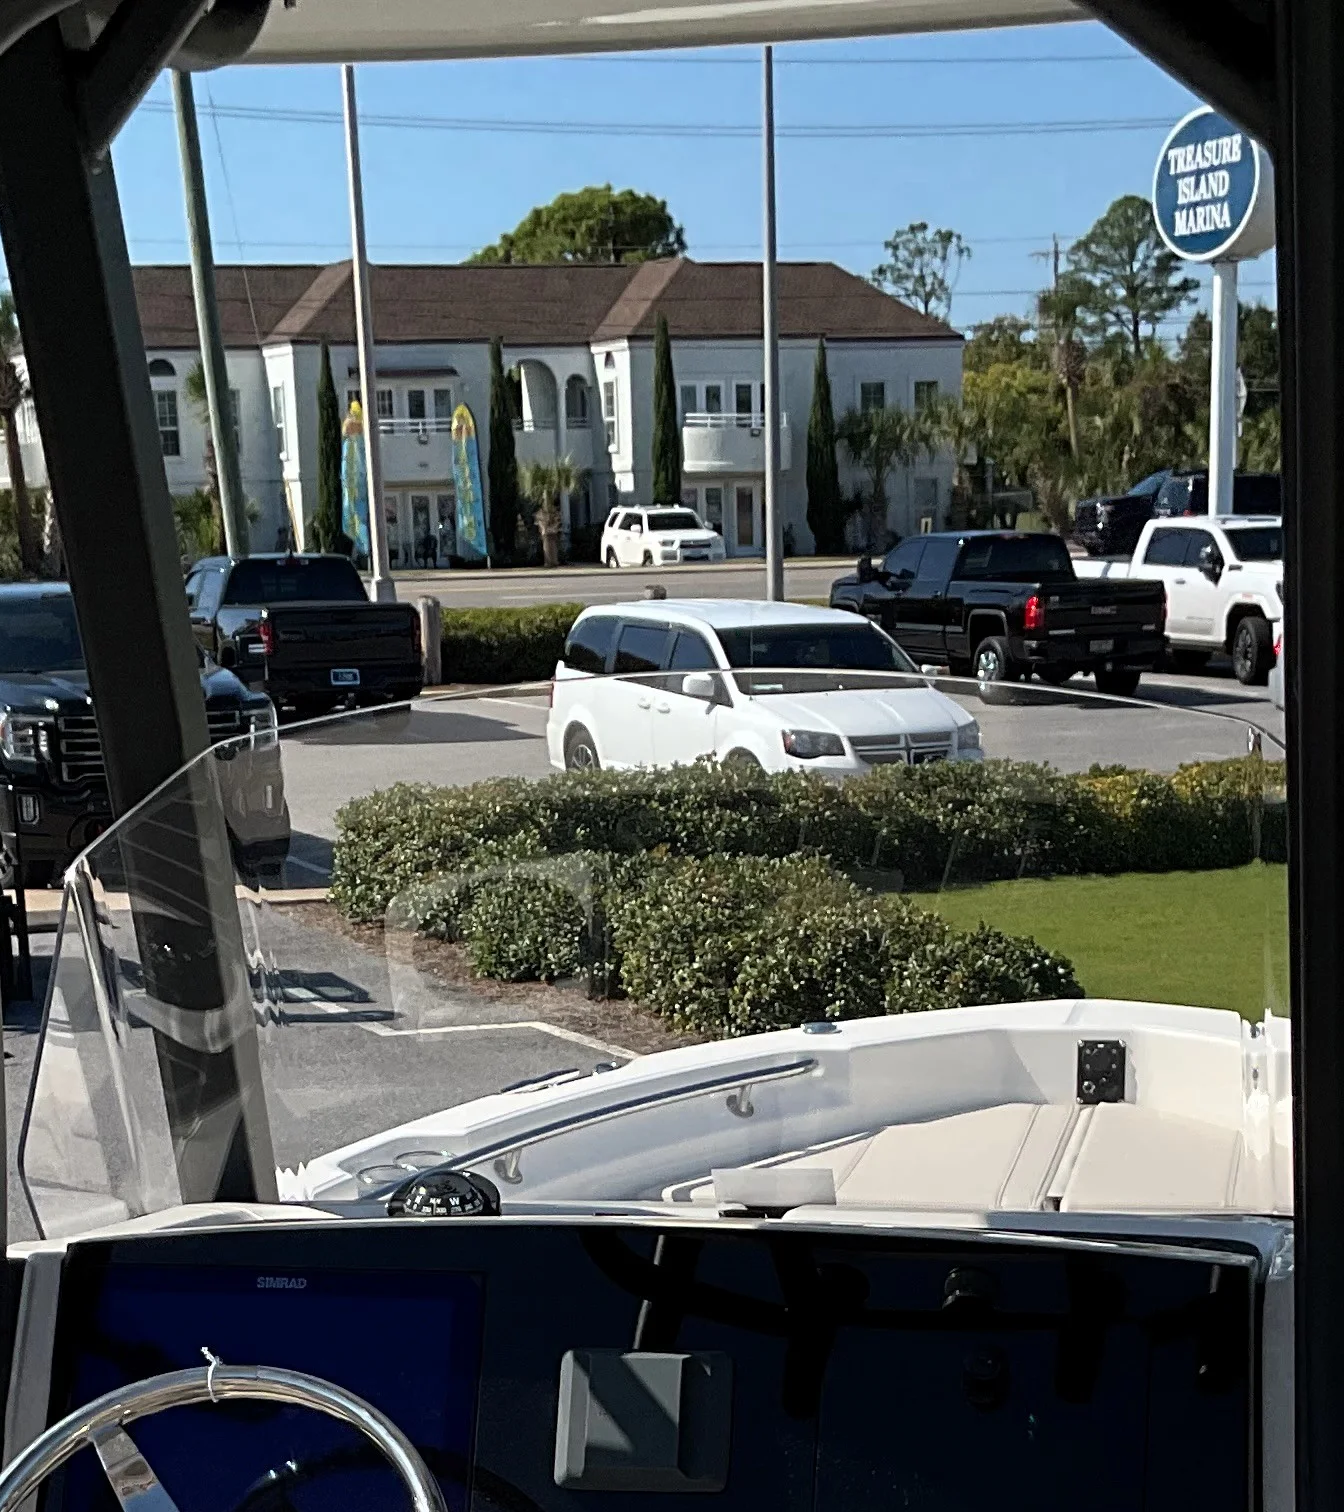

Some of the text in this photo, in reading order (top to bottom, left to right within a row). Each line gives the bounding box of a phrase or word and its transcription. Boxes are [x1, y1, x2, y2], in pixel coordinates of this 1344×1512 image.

[1167, 133, 1242, 175] TREASURE
[1177, 169, 1230, 204] ISLAND
[1174, 201, 1231, 236] MARINA
[449, 1197, 460, 1206] W
[256, 1276, 307, 1288] SIMRAD
